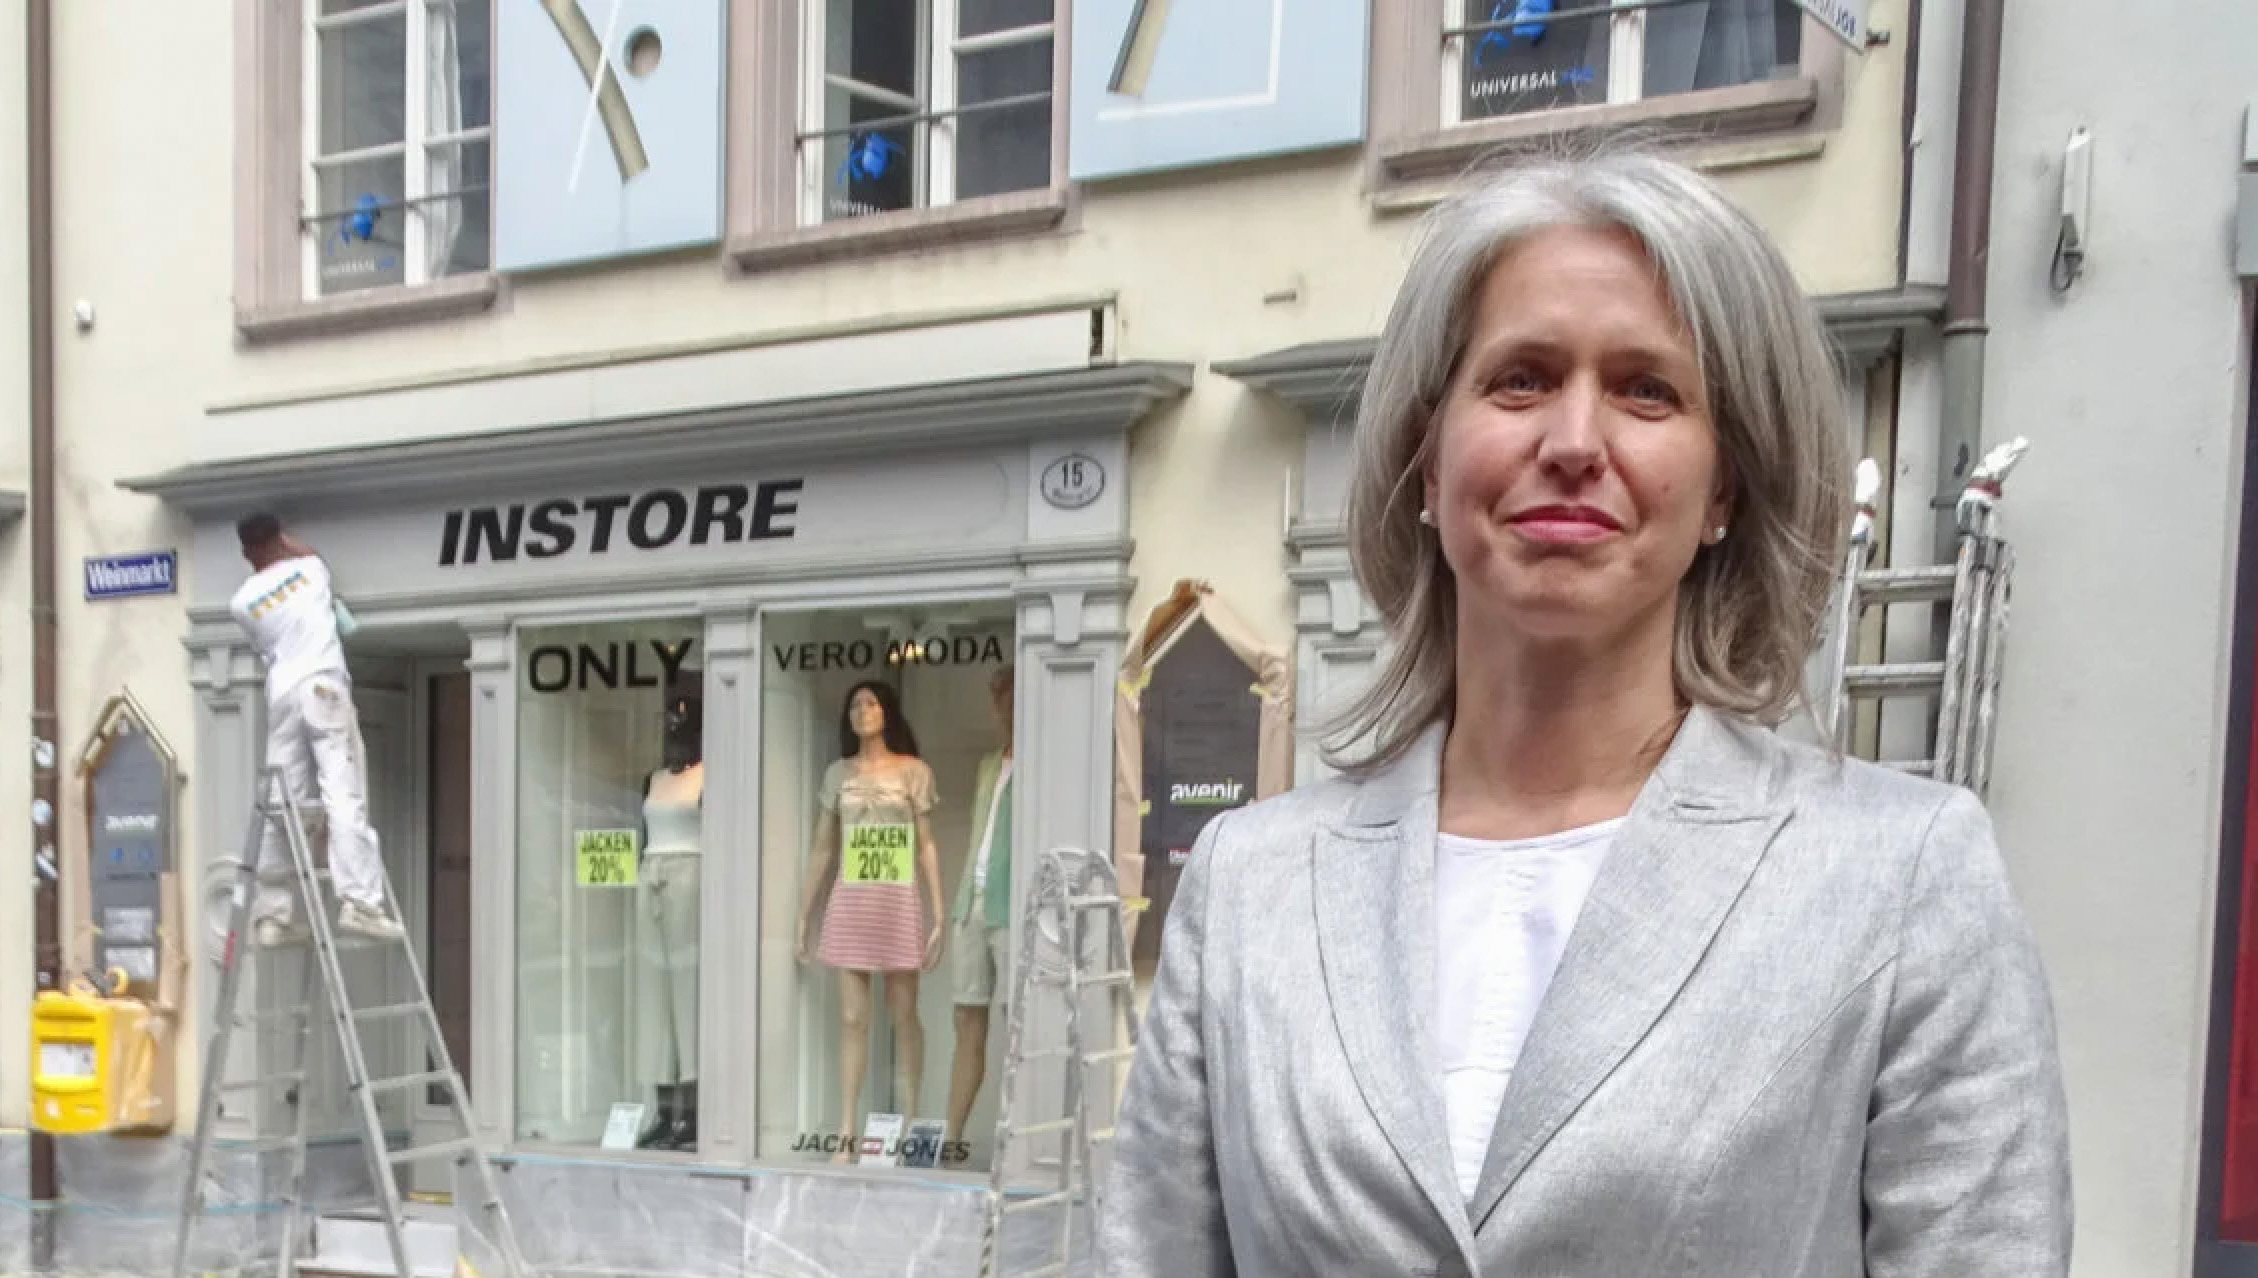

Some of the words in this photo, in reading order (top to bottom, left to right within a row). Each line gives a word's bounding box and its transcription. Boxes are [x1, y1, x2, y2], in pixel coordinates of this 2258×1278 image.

[1470, 69, 1557, 98] UNIVERSAL
[1062, 461, 1083, 488] 15
[438, 479, 804, 567] INSTORE
[87, 557, 171, 592] Weinmarkt
[528, 637, 693, 692] ONLY
[773, 639, 873, 672] VERO
[883, 634, 1003, 667] MODA
[1170, 777, 1244, 802] avenir
[580, 831, 632, 853] JACKEN
[850, 826, 907, 849] JACKEN
[588, 855, 625, 884] 20%
[858, 851, 899, 882] 20%
